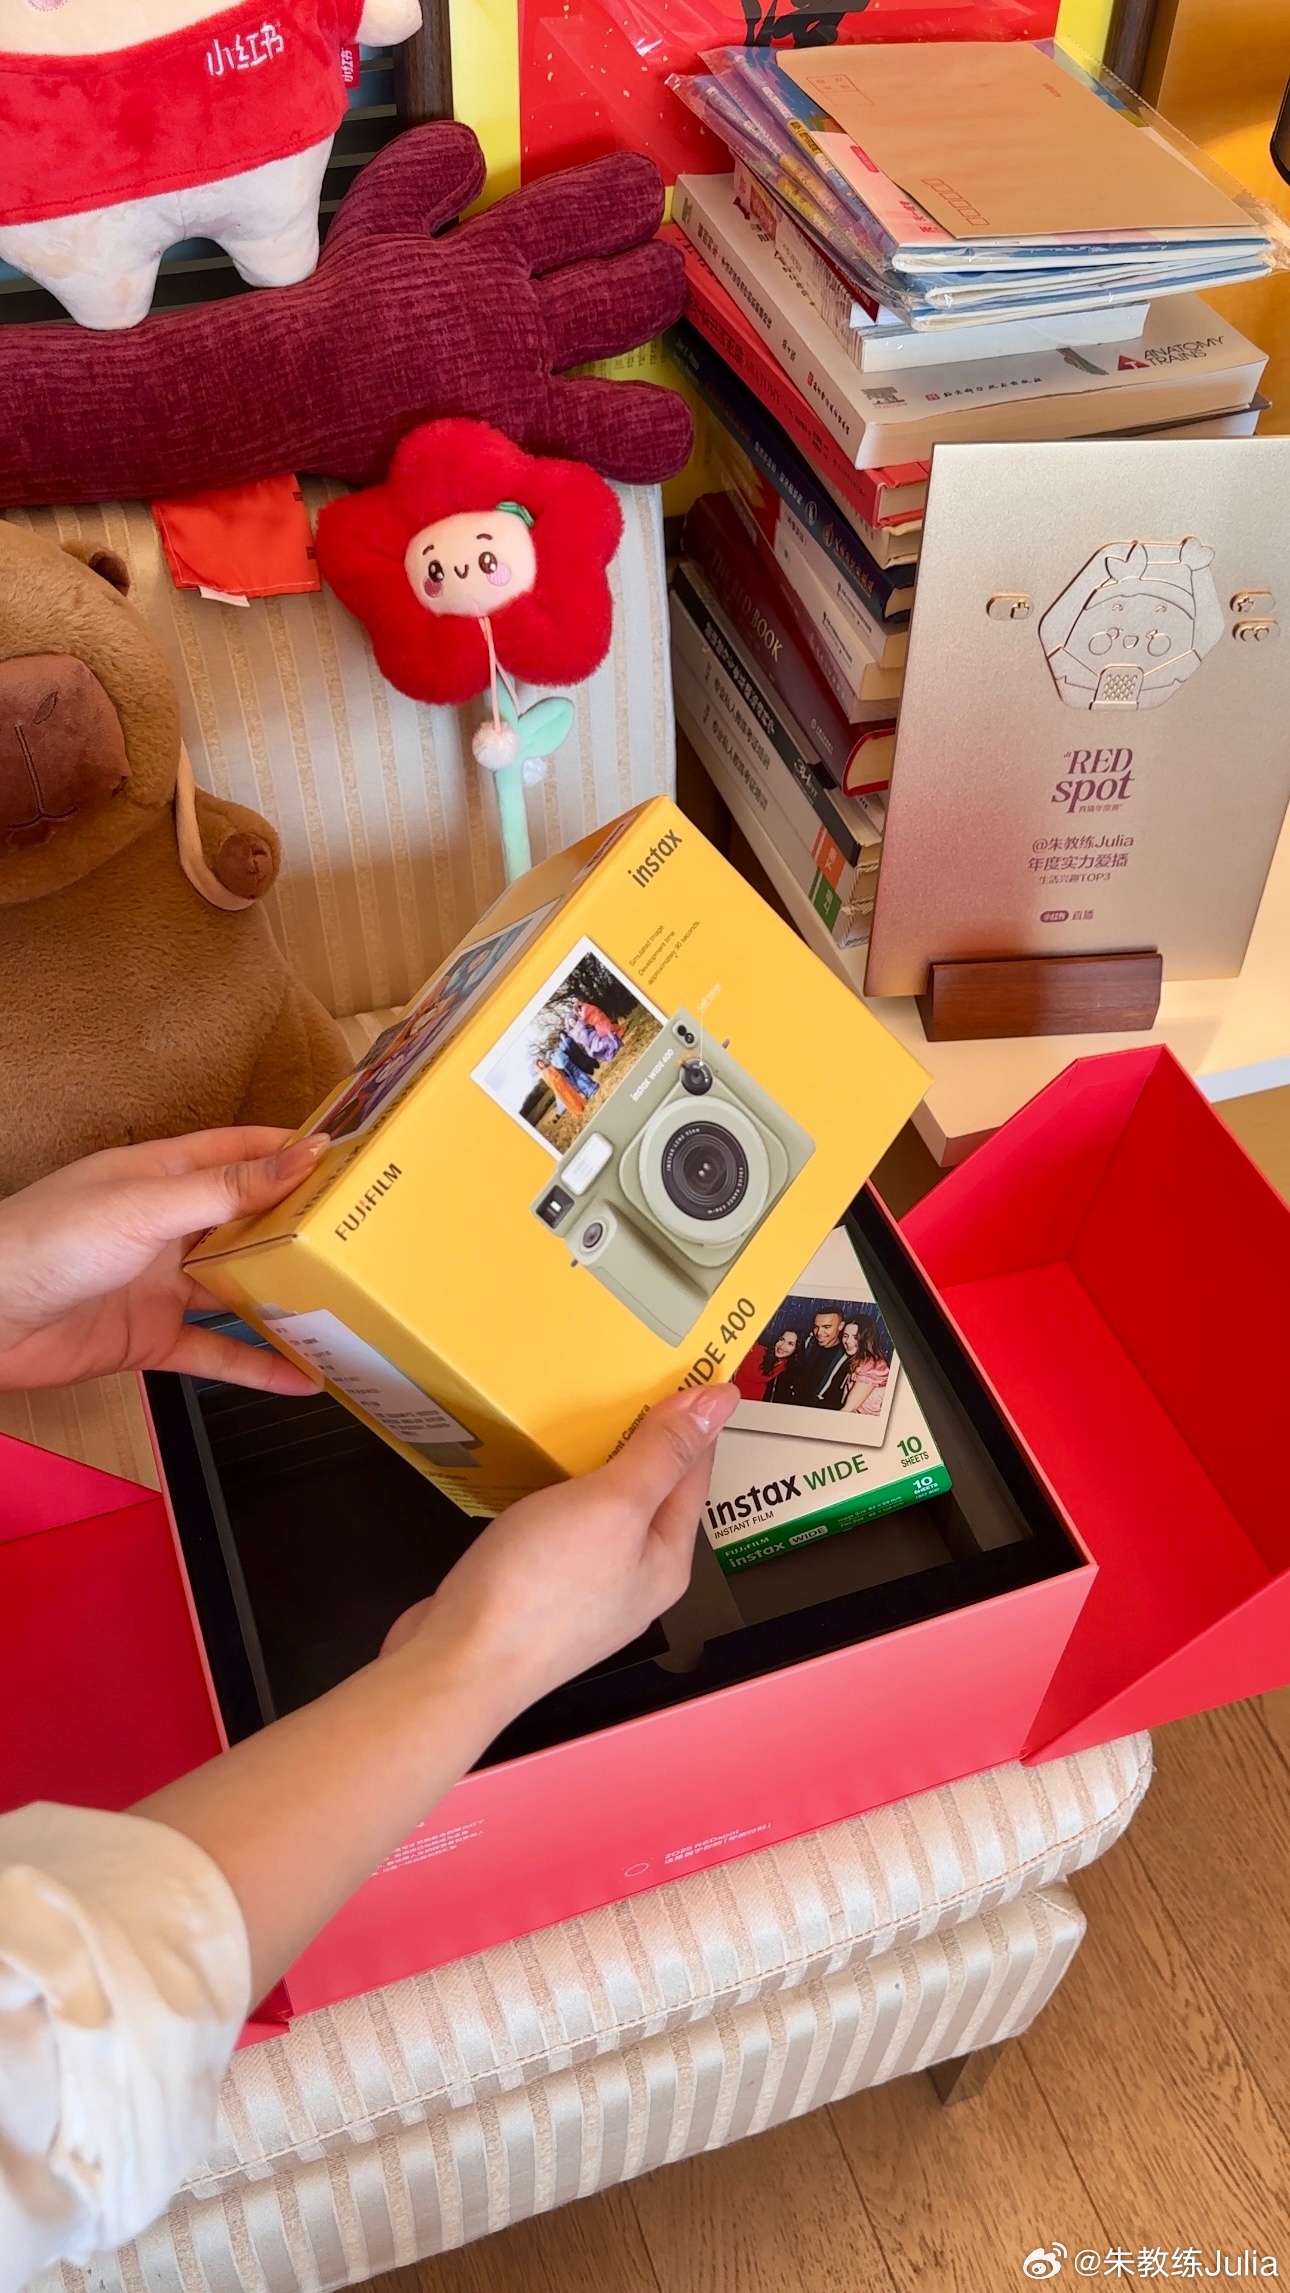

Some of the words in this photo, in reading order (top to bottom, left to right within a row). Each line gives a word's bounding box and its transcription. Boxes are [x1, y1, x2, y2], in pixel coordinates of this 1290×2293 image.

[206, 19, 285, 76] 小红书
[1143, 335, 1224, 361] ANATOMY
[1147, 348, 1207, 367] TRAINS
[751, 609, 783, 664] BOOK
[1067, 747, 1133, 774] RED
[1051, 770, 1135, 814] spot
[1032, 834, 1134, 853] @朱教练Julia
[627, 828, 683, 888] instax
[1027, 853, 1130, 872] 年度实力爱播
[1039, 872, 1111, 885] 生活兴趣TOP3
[1072, 910, 1094, 921] 直播
[628, 939, 651, 967] Simulated
[637, 940, 667, 977] Development
[664, 930, 676, 944] time
[648, 950, 678, 985] approximately
[674, 940, 683, 951] 90
[630, 1078, 651, 1102] instax
[648, 1060, 664, 1080] WIDE
[662, 1048, 674, 1063] 400
[334, 1162, 403, 1242] FUJIFILM
[720, 1297, 756, 1344] 400
[622, 1404, 650, 1441] Camera
[896, 1436, 922, 1457] 10
[901, 1451, 929, 1468] SHEETS
[705, 1475, 802, 1529] instax
[803, 1454, 869, 1491] WIDE
[913, 1476, 933, 1489] 10
[914, 1482, 938, 1495] SHEETS
[714, 1519, 750, 1539] INSTANT
[752, 1511, 774, 1525] FILM
[725, 1537, 770, 1557] FUJIFILM
[729, 1542, 785, 1568] instax
[792, 1527, 826, 1543] WIDE
